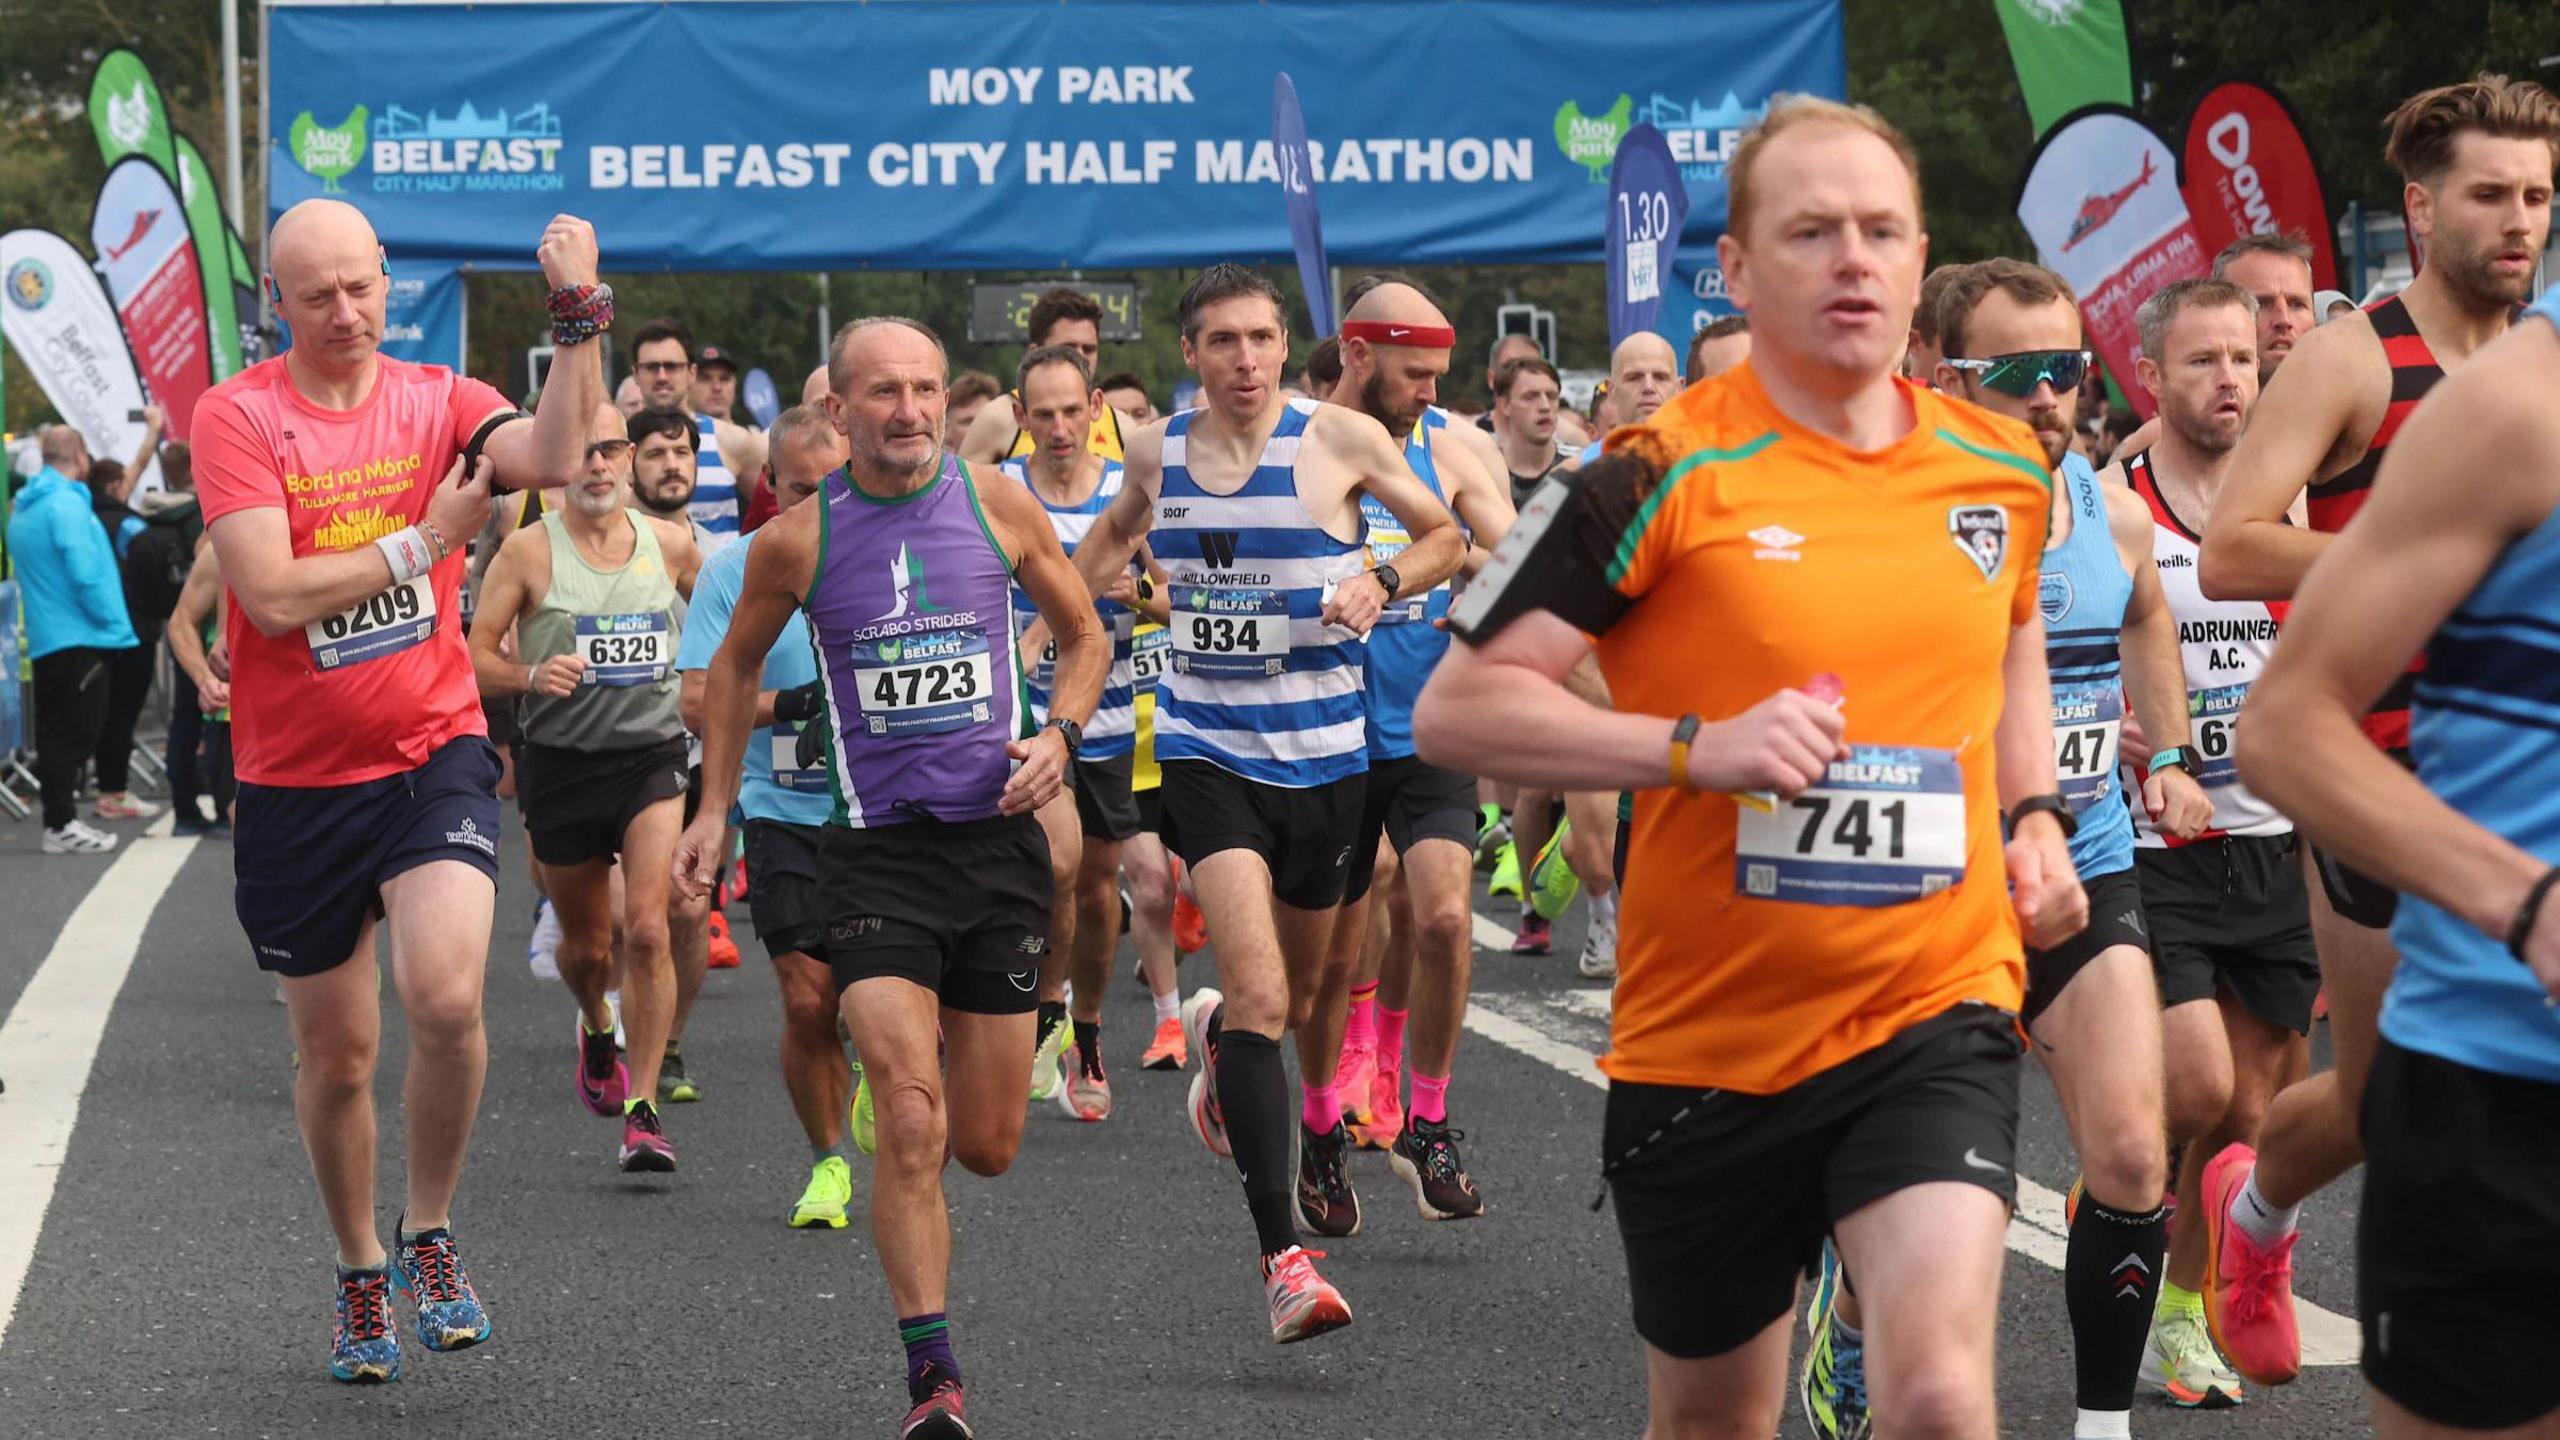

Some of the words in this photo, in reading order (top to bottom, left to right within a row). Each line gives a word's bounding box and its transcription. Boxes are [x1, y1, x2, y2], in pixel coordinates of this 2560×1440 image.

[929, 67, 1043, 105] MOY
[1058, 66, 1195, 103] PARK
[303, 128, 352, 149] Moy
[1568, 117, 1617, 139] Moy
[372, 138, 563, 174] BELFAST
[1667, 128, 1740, 163] ELF
[304, 148, 353, 173] park
[589, 142, 851, 188] BELFAST
[867, 142, 1007, 187] CITY
[1025, 140, 1177, 184] HALF
[1196, 138, 1534, 183] MARATHON
[372, 175, 411, 193] CITY
[416, 174, 459, 192] HALF
[465, 173, 564, 191] MARATHON
[1618, 191, 1670, 242] 1.30
[61, 324, 110, 397] Belfast
[286, 469, 334, 493] Bord
[337, 468, 361, 487] na
[364, 453, 421, 482] Móna
[298, 490, 359, 509] TULLAMORE
[2076, 473, 2096, 519] soar
[345, 508, 371, 524] HALF
[1162, 507, 1190, 519] soar
[314, 514, 407, 549] MARATHON
[1181, 573, 1271, 586] WILLOWFIELD
[322, 584, 420, 639] 6209
[1209, 599, 1262, 611] BELFAST
[614, 619, 653, 631] BELFAST
[853, 620, 912, 642] SCRABO
[914, 611, 977, 631] STRIDERS
[1192, 617, 1260, 652] 934
[2180, 619, 2279, 644] ADRUNNER
[589, 635, 657, 665] 6329
[903, 641, 962, 660] BELFAST
[2208, 647, 2245, 670] A.C.
[874, 660, 976, 707] 4723
[2053, 705, 2097, 720] ELFAST
[1828, 763, 1923, 785] BELFAST
[1792, 796, 1906, 858] 741
